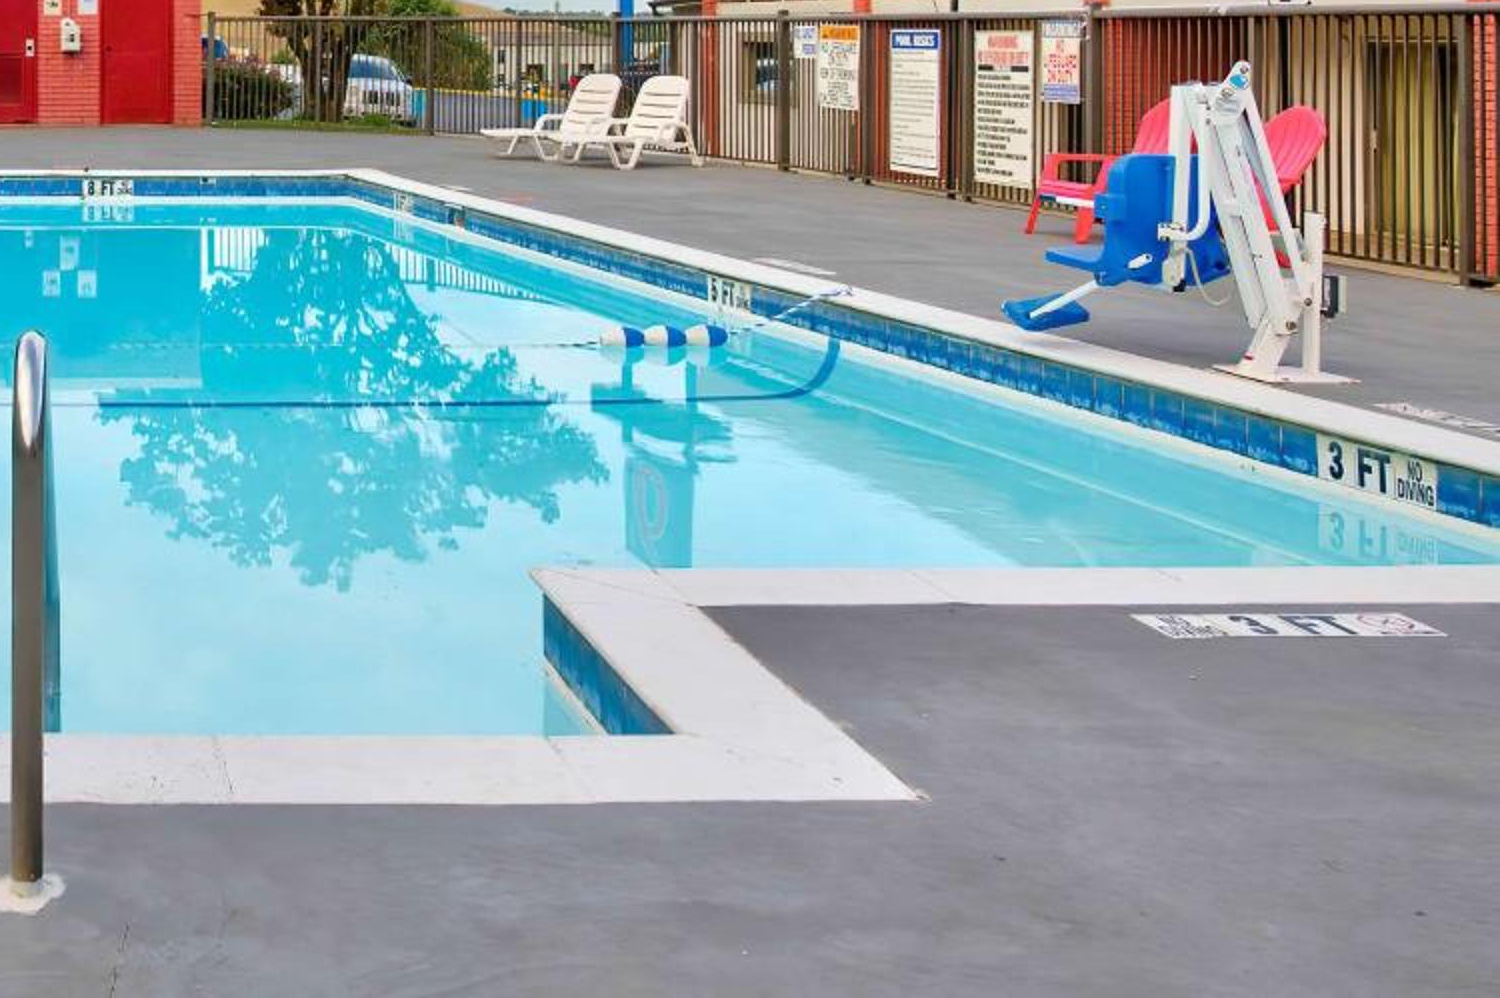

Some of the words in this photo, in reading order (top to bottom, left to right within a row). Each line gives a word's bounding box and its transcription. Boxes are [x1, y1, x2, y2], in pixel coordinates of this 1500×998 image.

[87, 180, 95, 196] 8
[101, 179, 116, 196] FT
[711, 277, 719, 302] 5
[721, 280, 735, 307] FT
[1328, 441, 1344, 480] 3
[1357, 447, 1391, 495] FT
[1407, 458, 1423, 482] NO
[1397, 477, 1435, 507] DIVING
[1228, 615, 1279, 635] 3
[1277, 615, 1358, 635] FT
